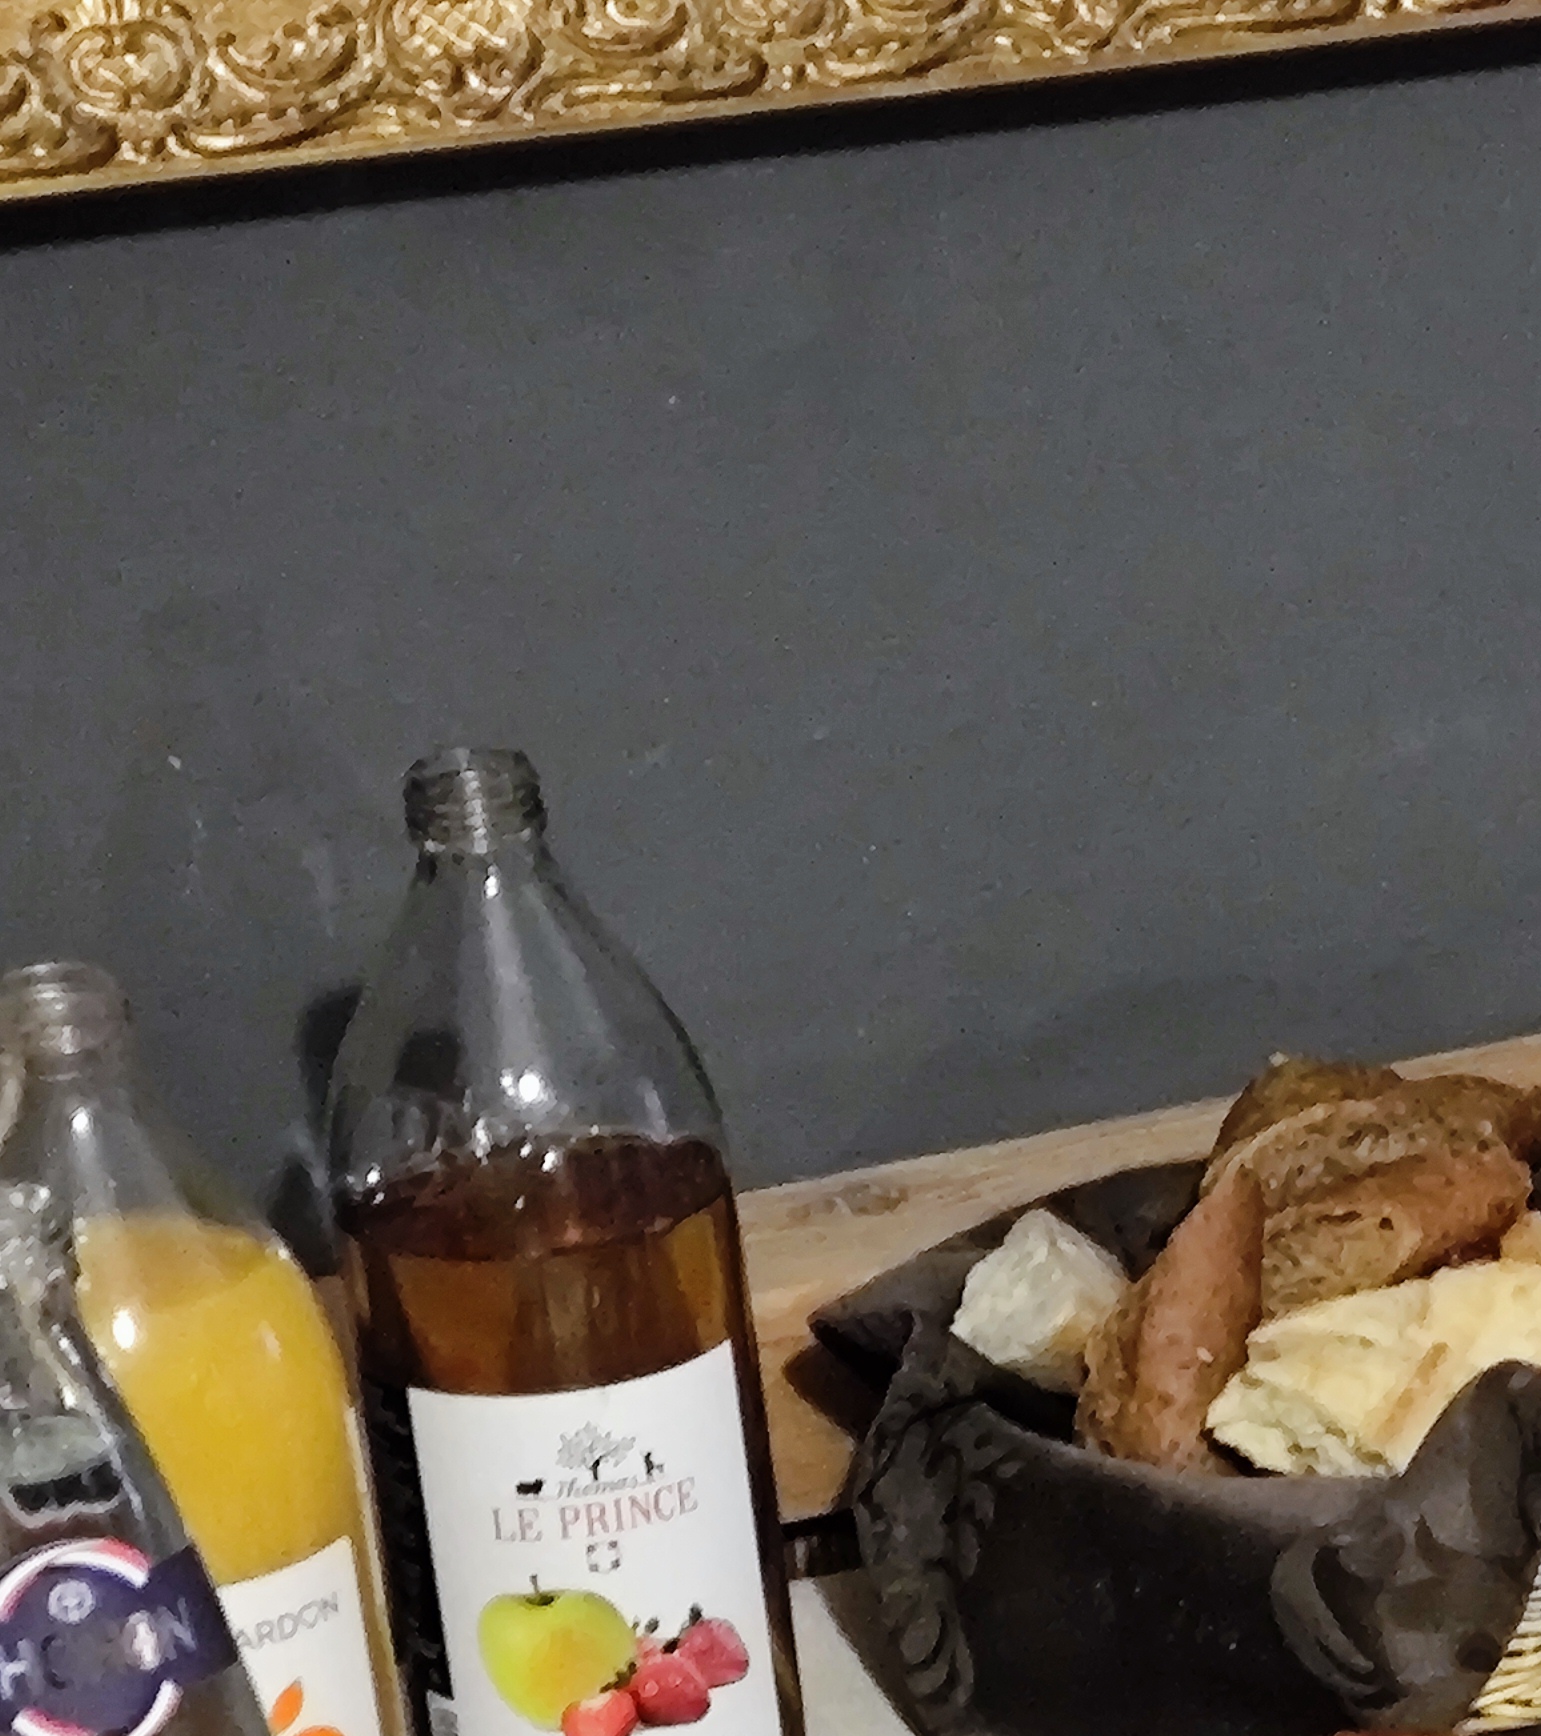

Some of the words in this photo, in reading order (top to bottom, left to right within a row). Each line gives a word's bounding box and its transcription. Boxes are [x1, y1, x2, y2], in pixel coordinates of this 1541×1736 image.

[492, 1507, 543, 1542] LE
[558, 1476, 698, 1540] PRINCE
[235, 1590, 339, 1650] ARDON
